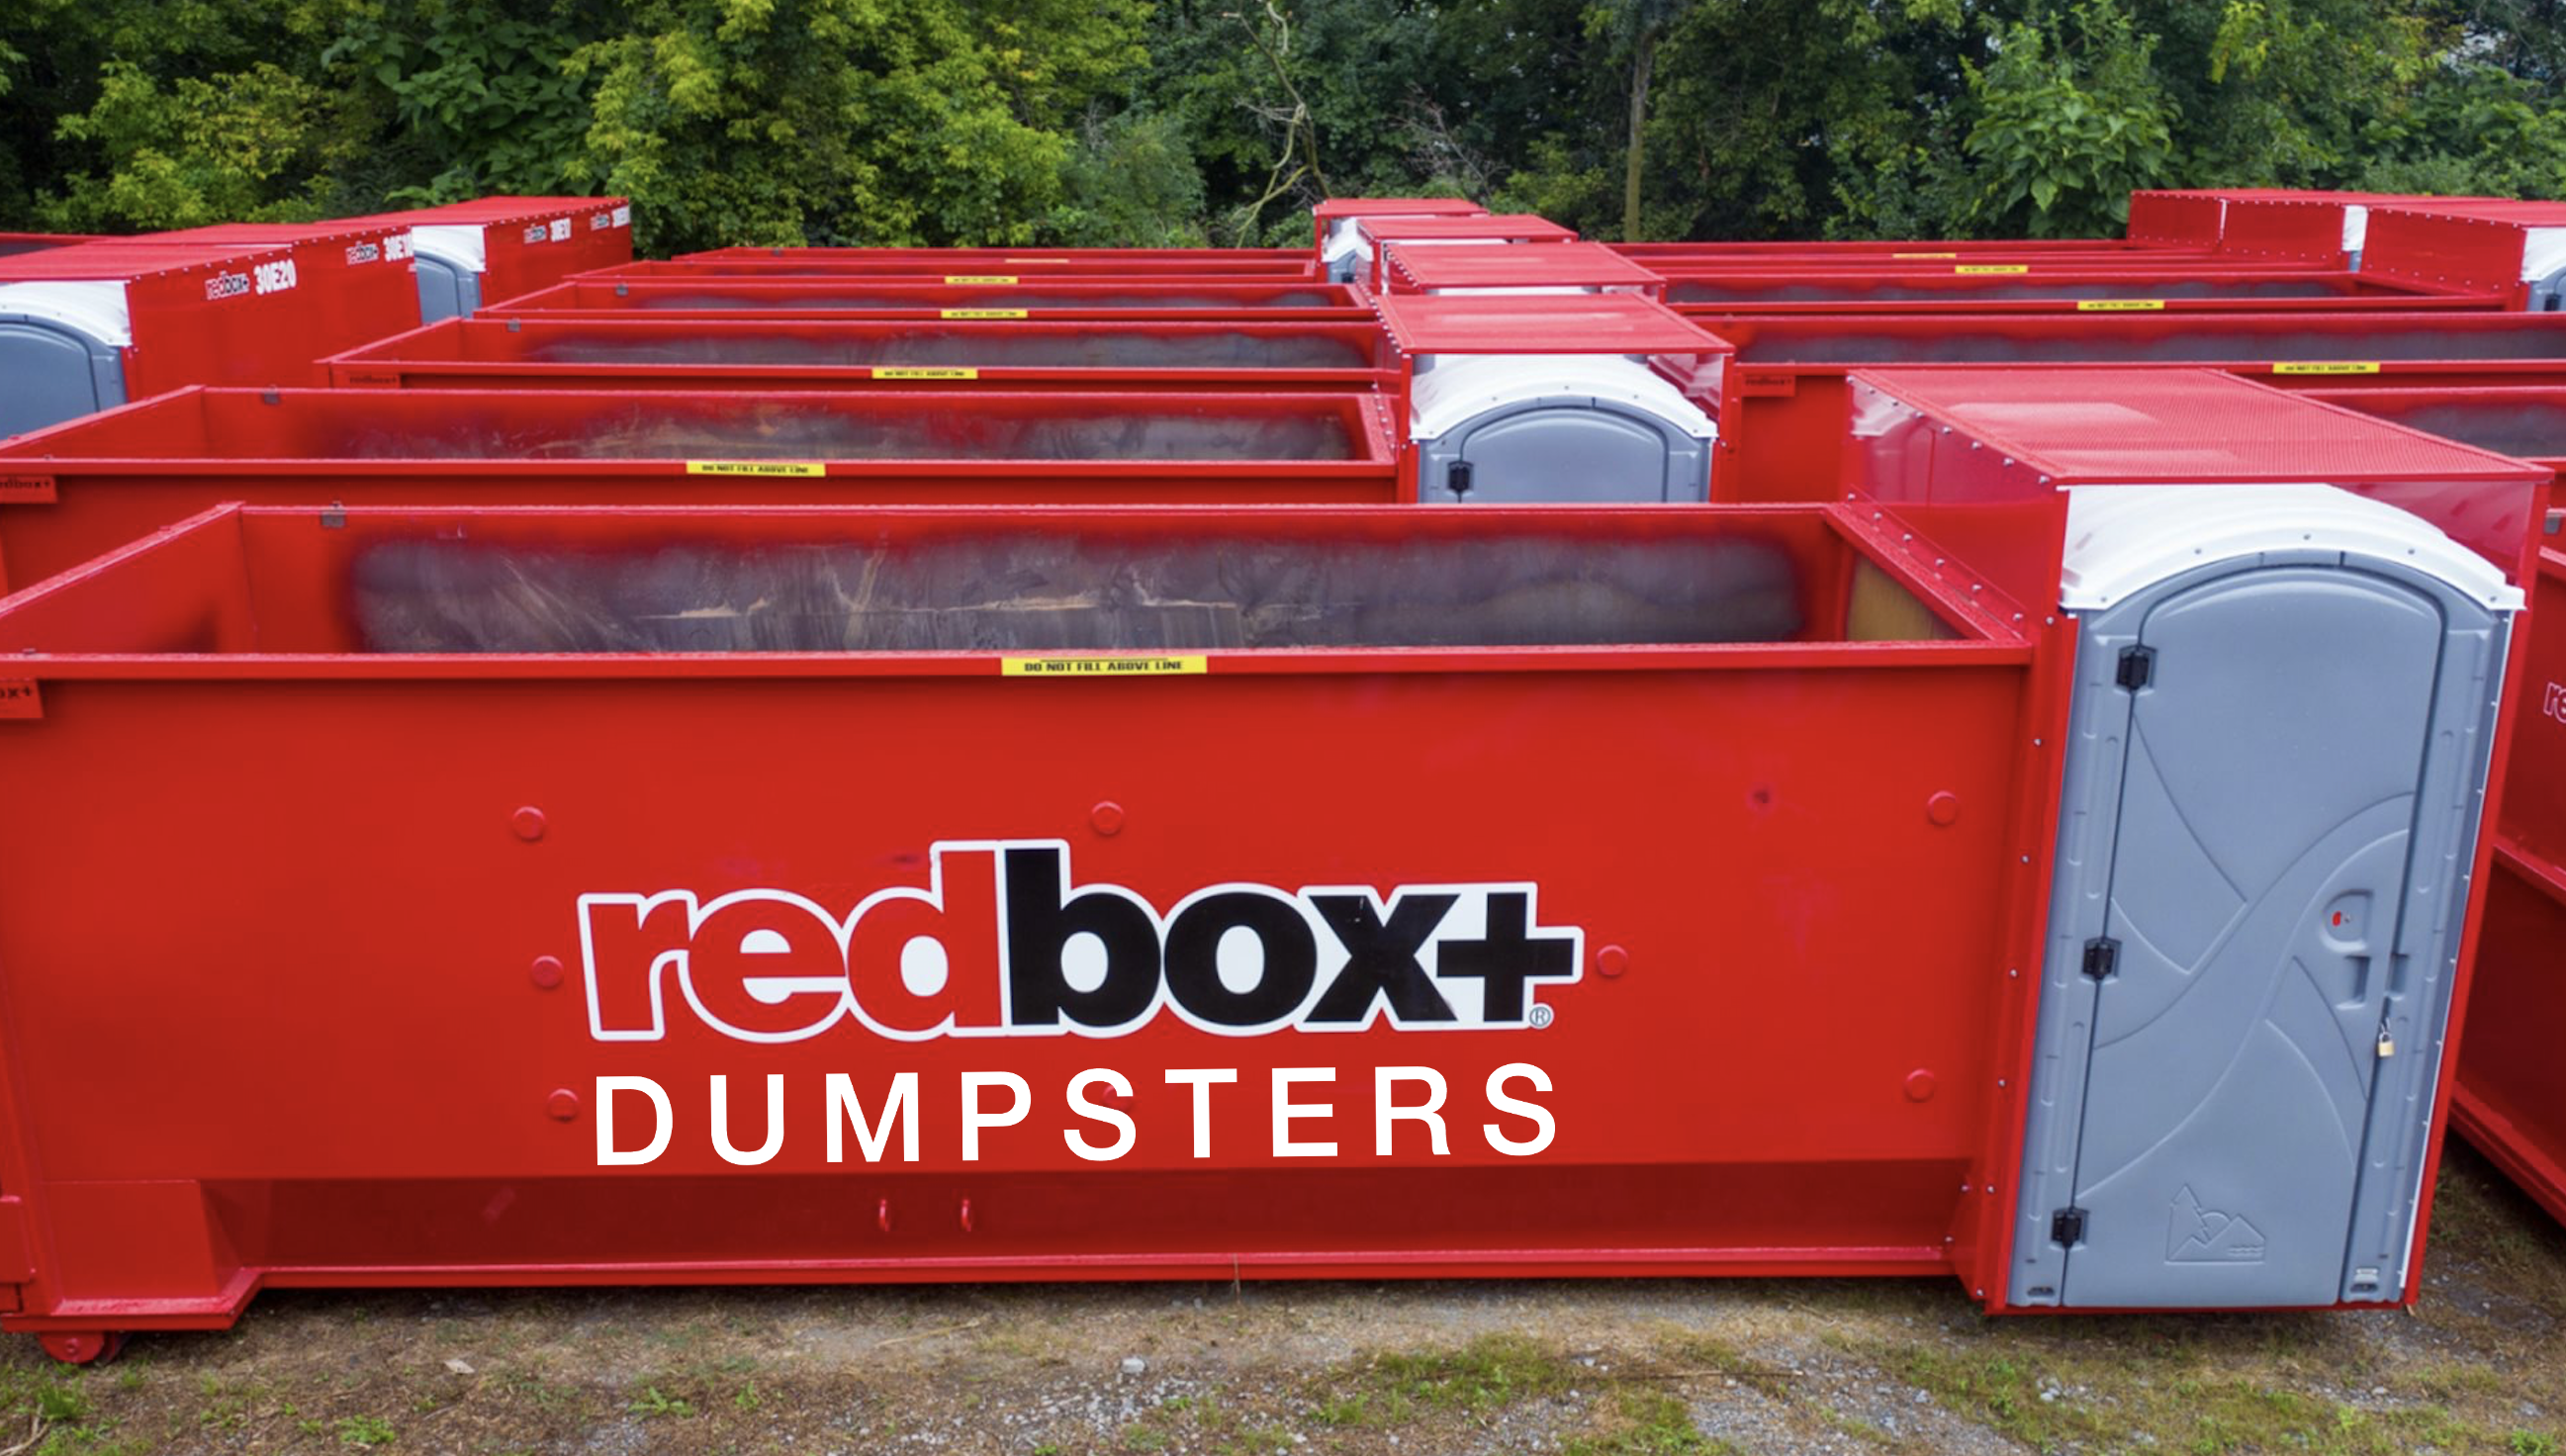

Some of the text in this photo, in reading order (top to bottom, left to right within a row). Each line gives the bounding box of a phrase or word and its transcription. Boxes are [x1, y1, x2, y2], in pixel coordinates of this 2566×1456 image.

[253, 258, 297, 295] 30E20
[1025, 661, 1182, 672] DO NOT FILL ABOVE LINE
[596, 1062, 1556, 1165] DUMPSTERS
